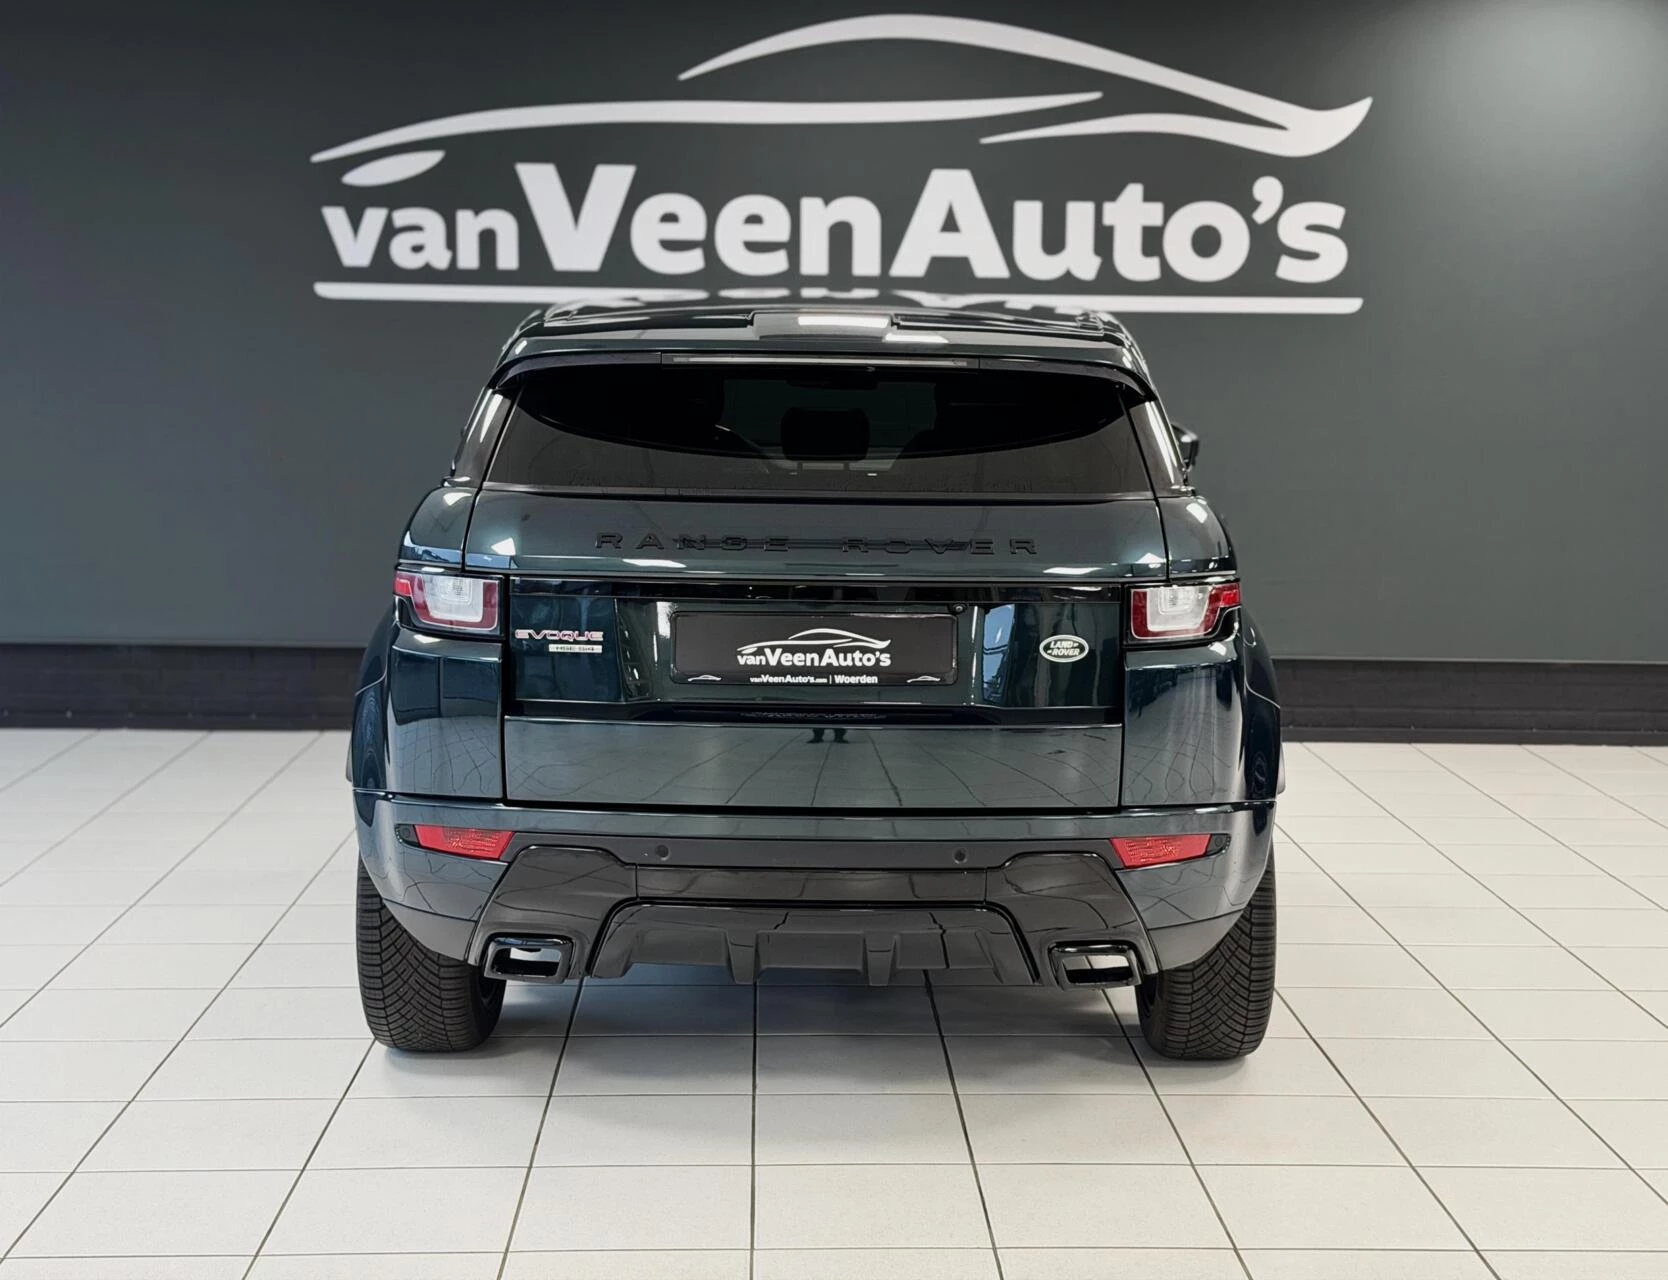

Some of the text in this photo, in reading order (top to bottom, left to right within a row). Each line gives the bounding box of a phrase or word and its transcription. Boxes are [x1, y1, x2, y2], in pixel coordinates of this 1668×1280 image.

[596, 532, 1037, 554] RANGE ROVER
[514, 629, 604, 642] EVOQUE
[1050, 640, 1074, 648] LAND
[1051, 648, 1080, 656] ROVER
[834, 674, 878, 684] Woerden
